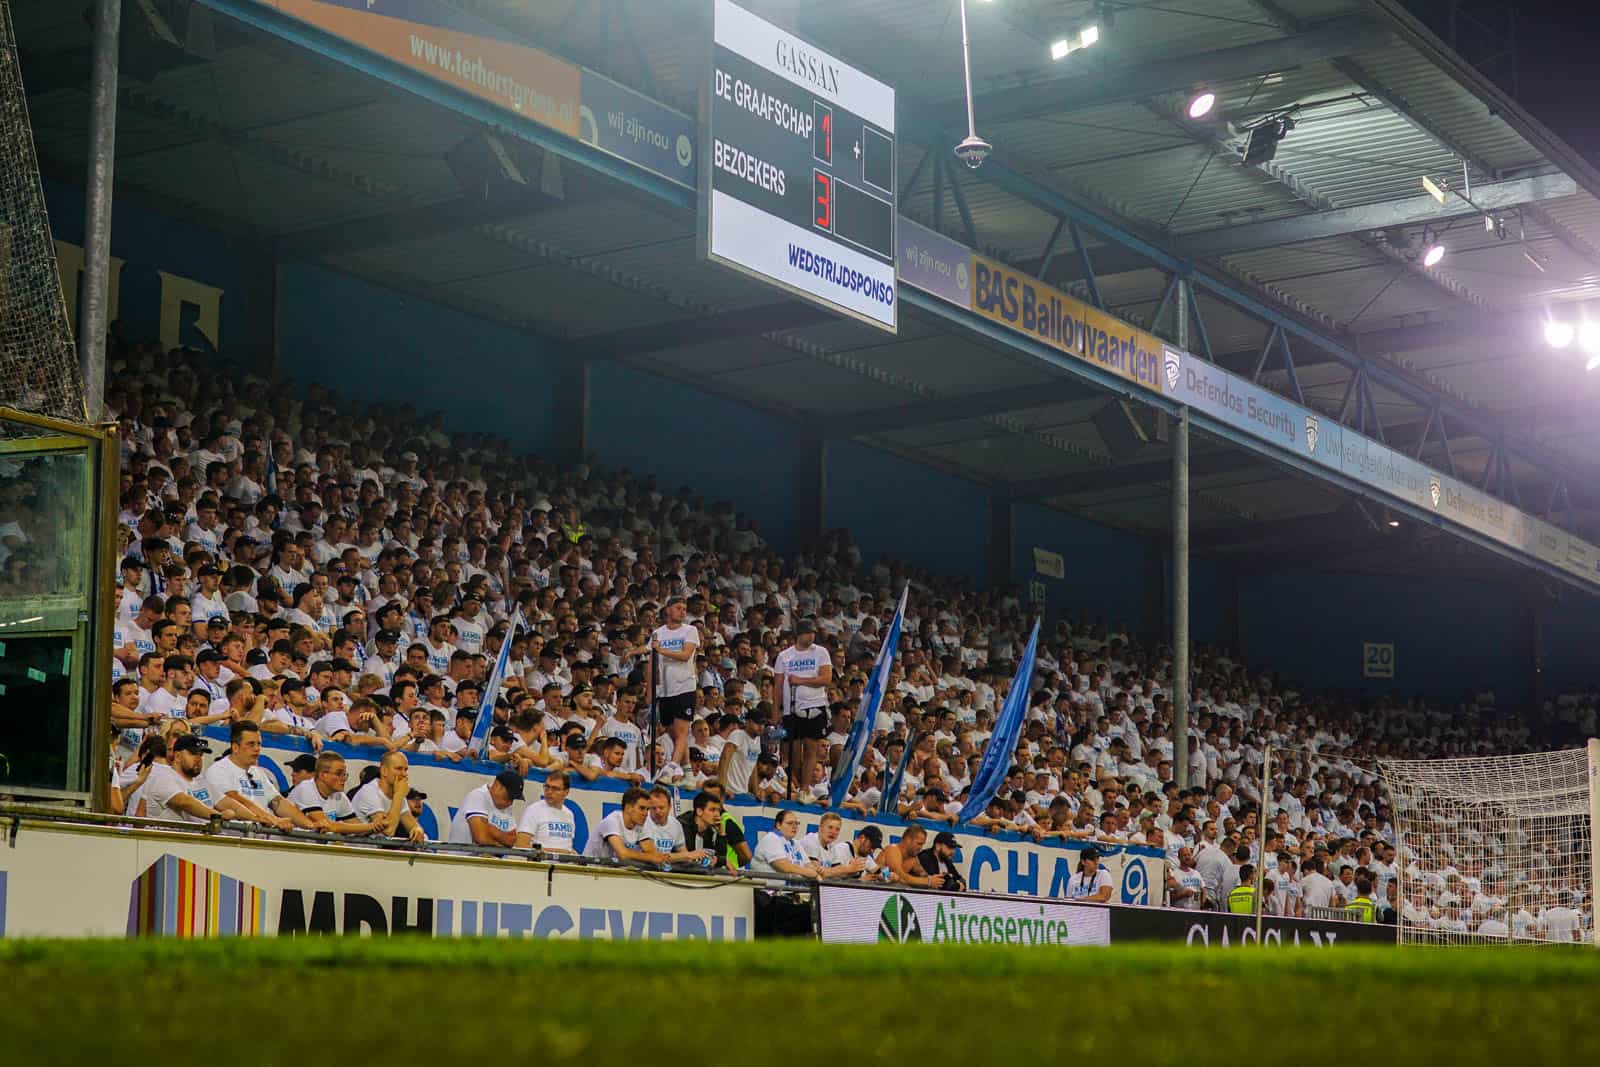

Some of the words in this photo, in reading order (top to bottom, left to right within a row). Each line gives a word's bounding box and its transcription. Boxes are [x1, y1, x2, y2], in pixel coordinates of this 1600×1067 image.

[776, 39, 840, 96] GASSAN
[607, 111, 624, 137] wij
[624, 116, 646, 145] zijn
[714, 68, 732, 101] DE
[734, 79, 813, 139] GRAAFSCHAP
[821, 113, 831, 160] 1
[714, 138, 786, 196] BEZOEKERS
[816, 172, 831, 229] 3
[788, 241, 895, 307] WEDSTRIJDSPONSO
[975, 261, 1020, 323] BAS
[1022, 282, 1159, 386] Ballonvaarten
[1185, 366, 1244, 415] Defendos
[1247, 395, 1298, 443] Security
[1367, 646, 1392, 665] 20
[933, 897, 1068, 945] Aircoservice
